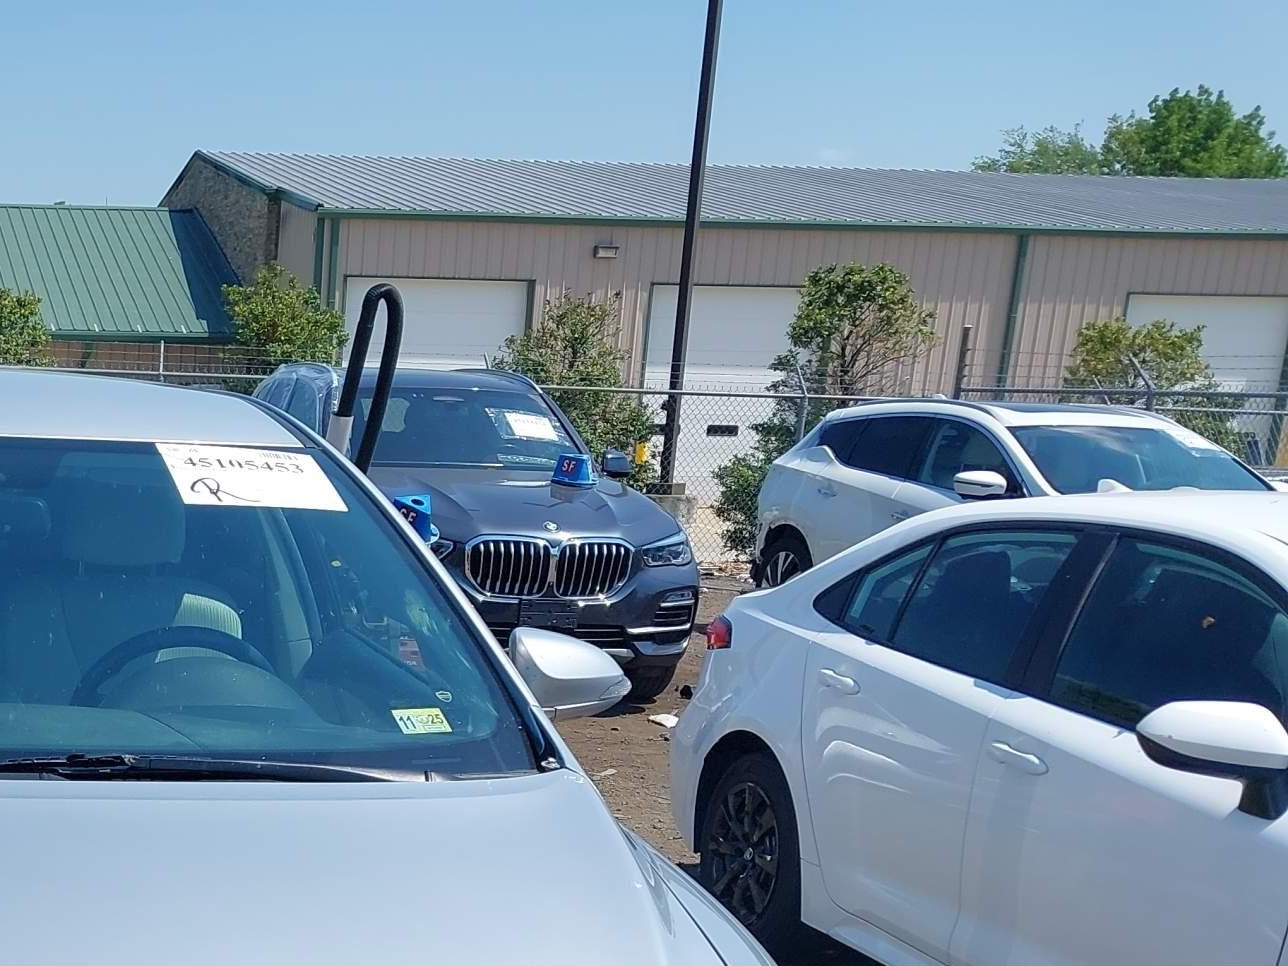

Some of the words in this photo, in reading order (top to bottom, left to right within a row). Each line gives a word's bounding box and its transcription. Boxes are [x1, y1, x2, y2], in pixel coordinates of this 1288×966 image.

[184, 456, 304, 474] 45105453
[561, 459, 577, 473] SF
[398, 715, 417, 730] 11
[427, 713, 444, 724] 25
